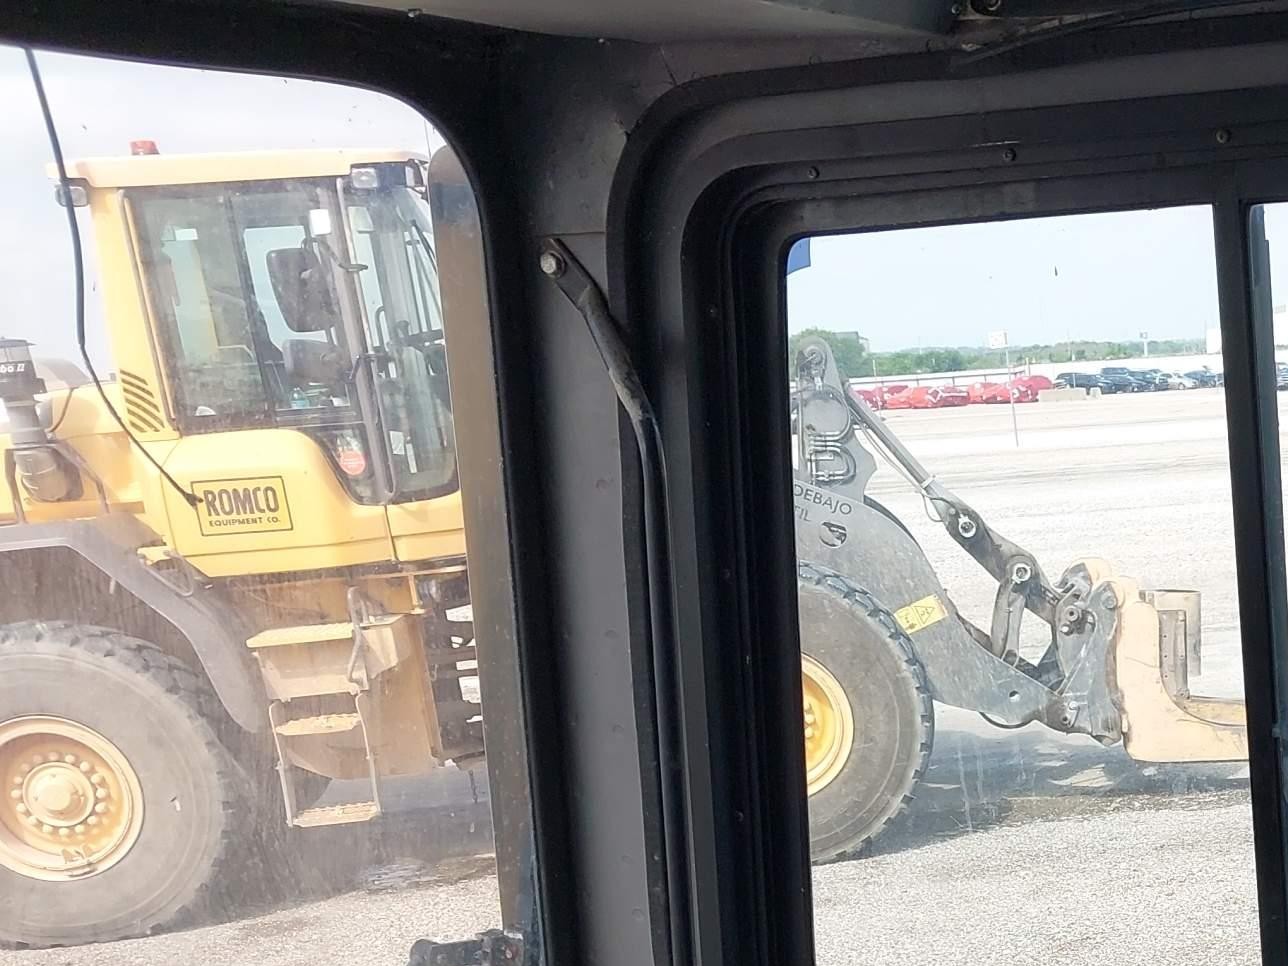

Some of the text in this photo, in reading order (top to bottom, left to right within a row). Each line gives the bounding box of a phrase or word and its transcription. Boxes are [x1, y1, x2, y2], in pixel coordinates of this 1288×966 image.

[203, 486, 280, 516] ROMCO
[209, 516, 281, 527] EQUIPMENT CO.
